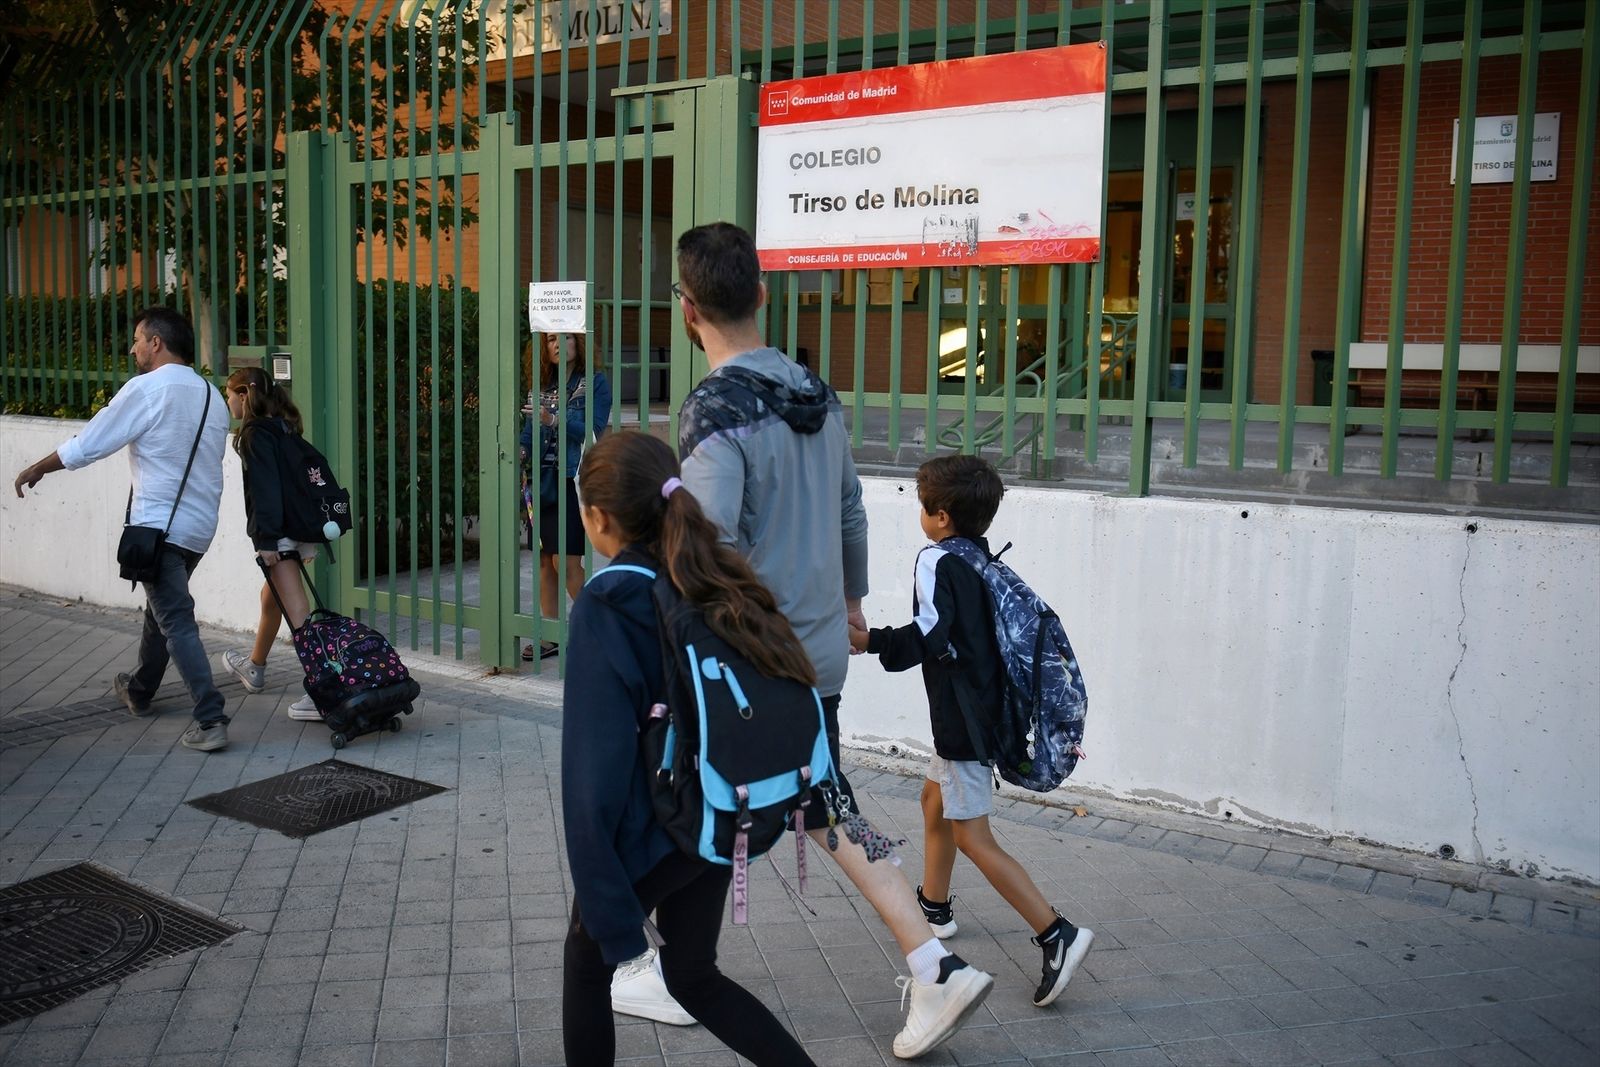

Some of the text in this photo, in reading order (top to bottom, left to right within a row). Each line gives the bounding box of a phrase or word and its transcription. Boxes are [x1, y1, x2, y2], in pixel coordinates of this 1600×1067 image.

[791, 85, 898, 106] Comunidad de Madrid
[789, 146, 882, 170] COLEGIO
[1474, 162, 1501, 170] TIRSO
[788, 184, 980, 214] Tirso de Molina
[788, 250, 908, 265] CONSEJERÍA DE EDUCACIÓN
